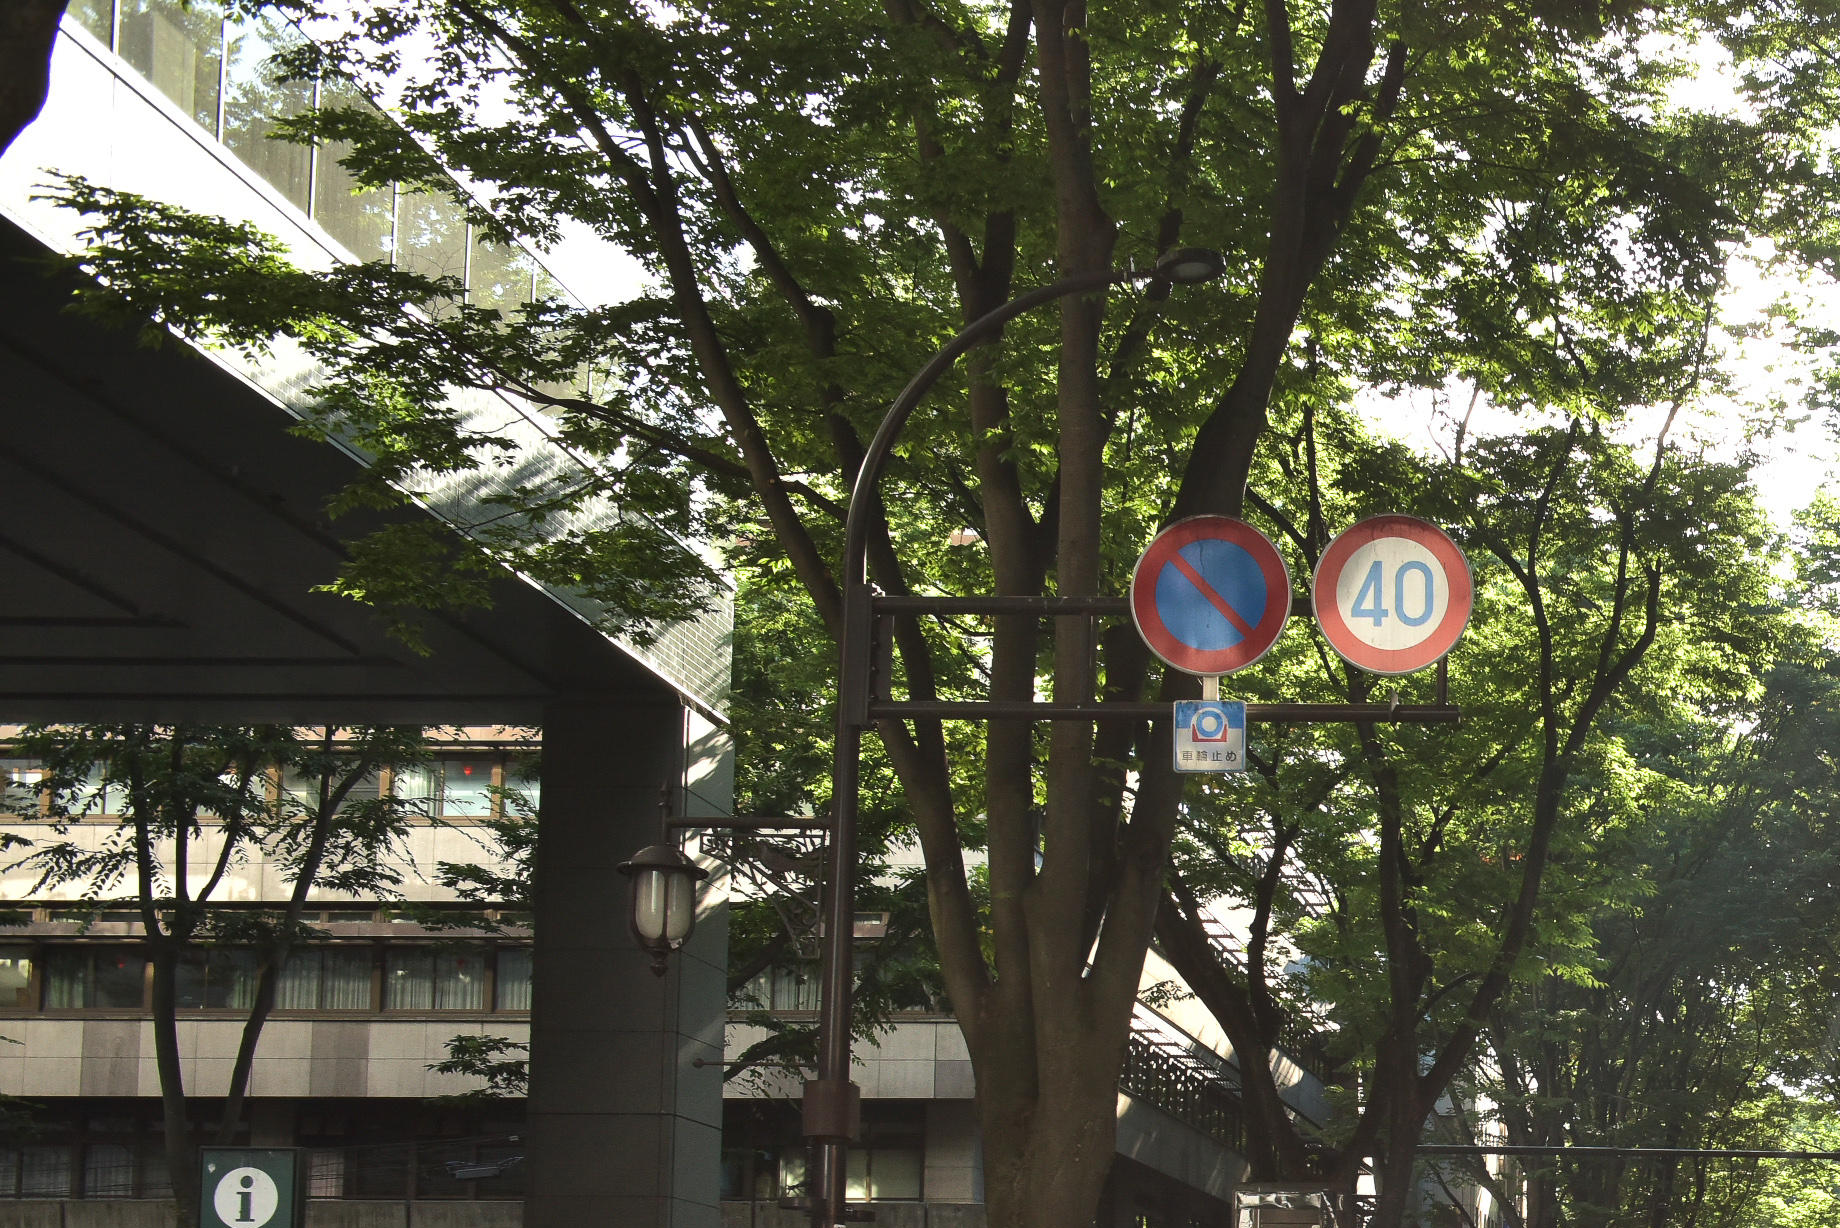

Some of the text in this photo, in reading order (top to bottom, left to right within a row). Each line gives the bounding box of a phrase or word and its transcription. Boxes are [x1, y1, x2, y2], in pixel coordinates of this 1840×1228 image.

[1352, 560, 1435, 628] 40
[1181, 749, 1238, 765] 車輪止め
